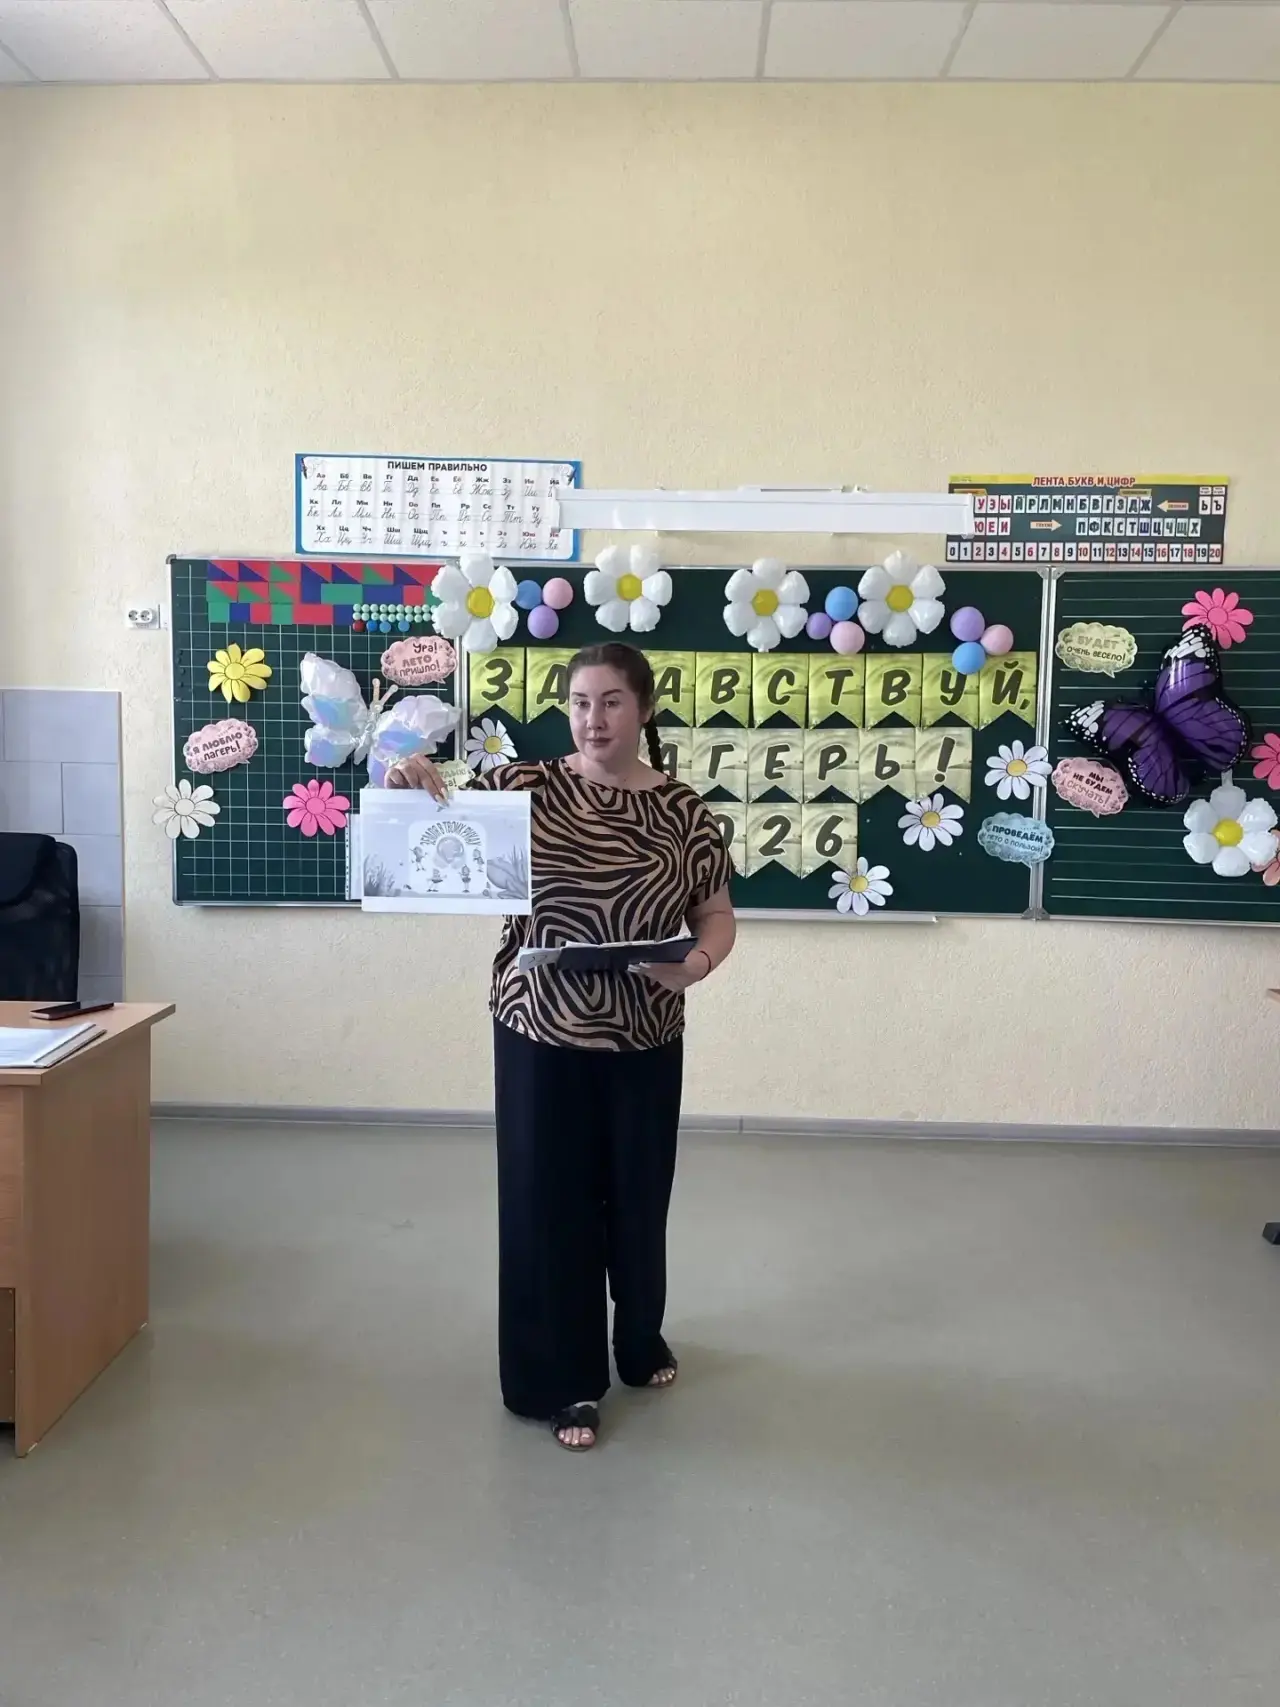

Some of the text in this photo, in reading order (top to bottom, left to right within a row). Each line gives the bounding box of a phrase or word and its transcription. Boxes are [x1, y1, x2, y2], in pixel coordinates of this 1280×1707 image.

[388, 461, 488, 472] ПИШЕМ ПРАВИЛЬНО
[1033, 476, 1136, 488] ЛЕНТА БУКВ И ЦИФР
[950, 547, 1220, 557] 0 1 2 3 4 5 6 7 8 9 10 11 12 13 14 15 16 17 18 19 20
[1078, 636, 1118, 649] БУДЕТ
[402, 655, 432, 668] ЛЕТО
[481, 658, 1030, 710] ЗДАВСТВУЙ,
[193, 732, 242, 754] Я ЛЮБЛЮ
[661, 736, 956, 782] АГЕРЬ!
[1073, 772, 1112, 794] НЕ БУДЕМ
[1089, 772, 1104, 782] МЫ
[715, 814, 844, 858] 026
[992, 826, 1043, 843] ПРОВЕДЁМ
